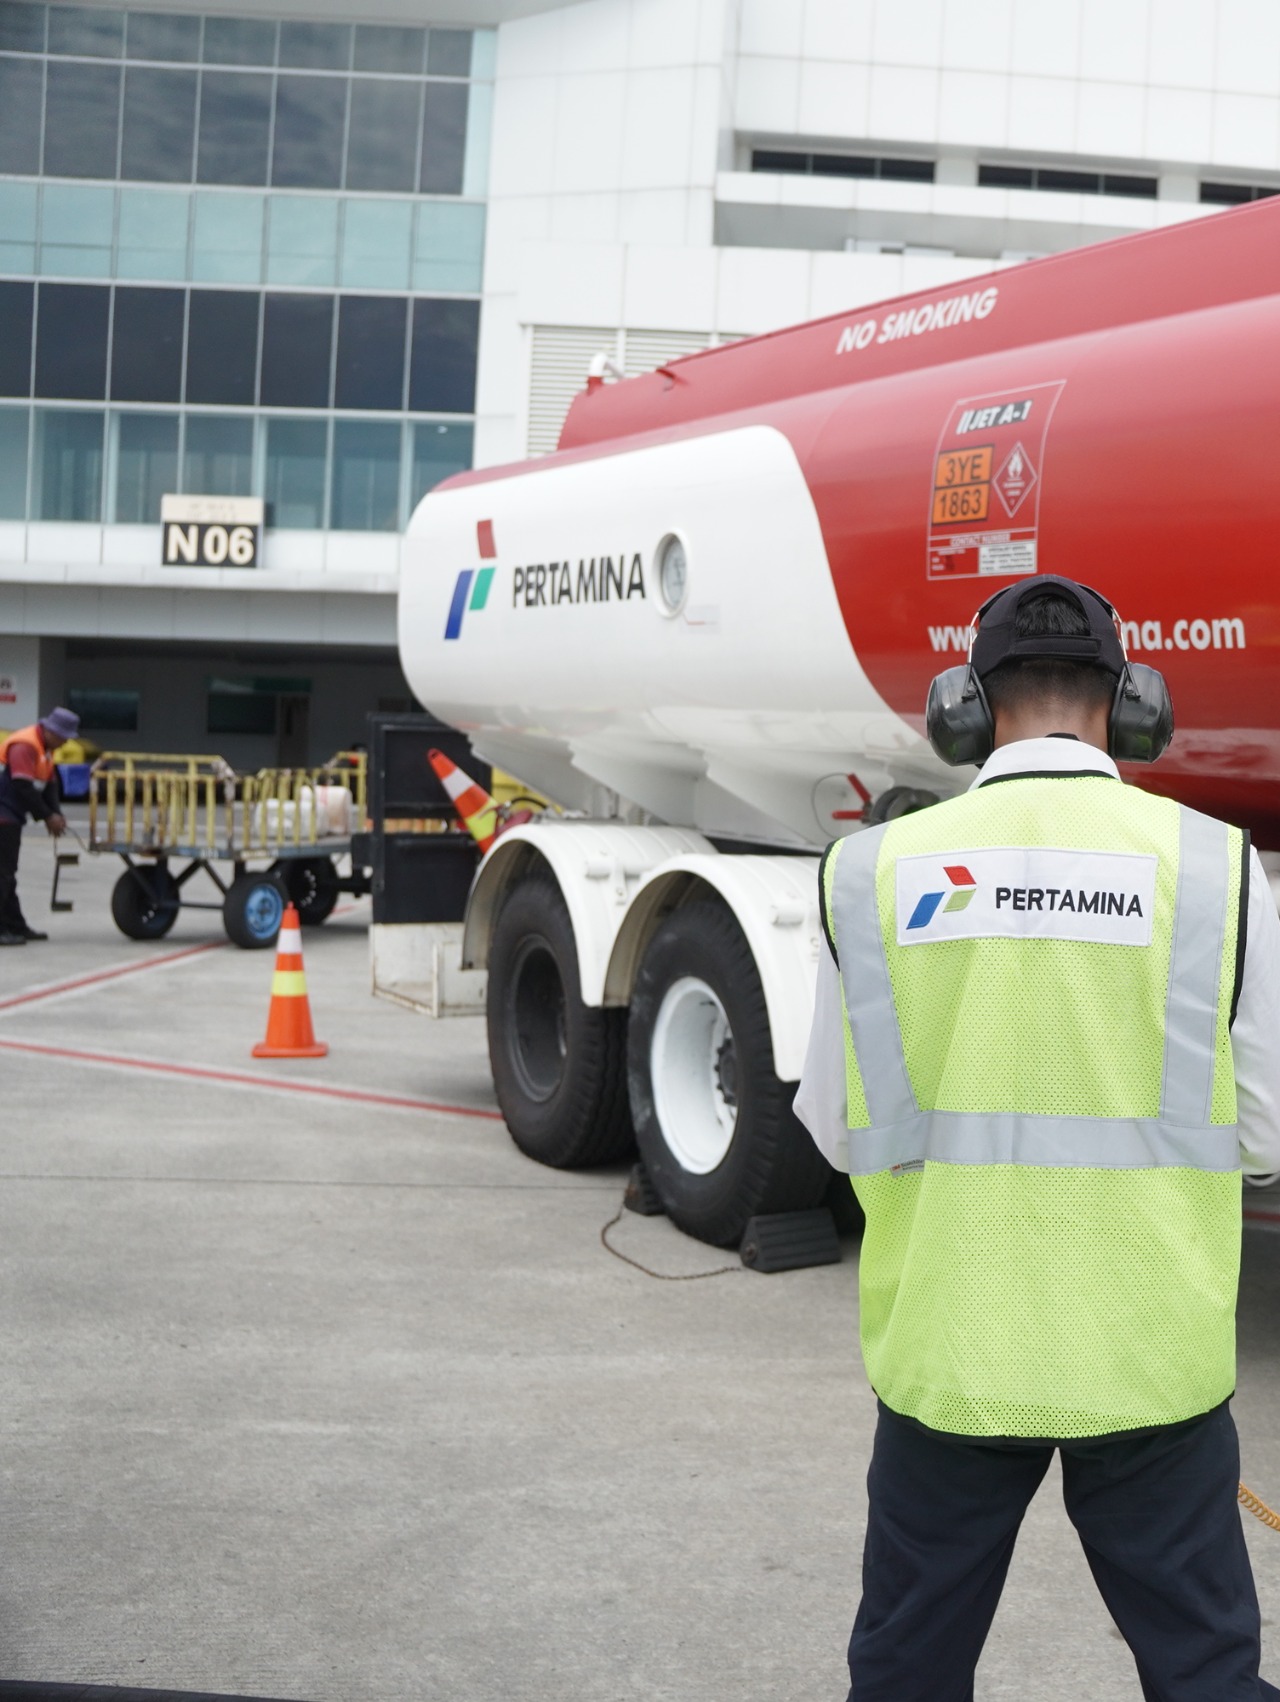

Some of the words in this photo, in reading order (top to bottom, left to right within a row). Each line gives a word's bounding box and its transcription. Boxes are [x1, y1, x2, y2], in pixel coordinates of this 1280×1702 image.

[835, 319, 878, 355] NO
[877, 287, 999, 344] SMOKING
[968, 406, 1001, 431] JET
[998, 400, 1033, 425] A-1
[945, 454, 983, 485] 3YE
[939, 488, 983, 519] 1863
[167, 523, 199, 563] N
[203, 524, 254, 566] 06
[512, 552, 646, 609] PERTAMINA
[995, 886, 1144, 918] PERTAMINA
